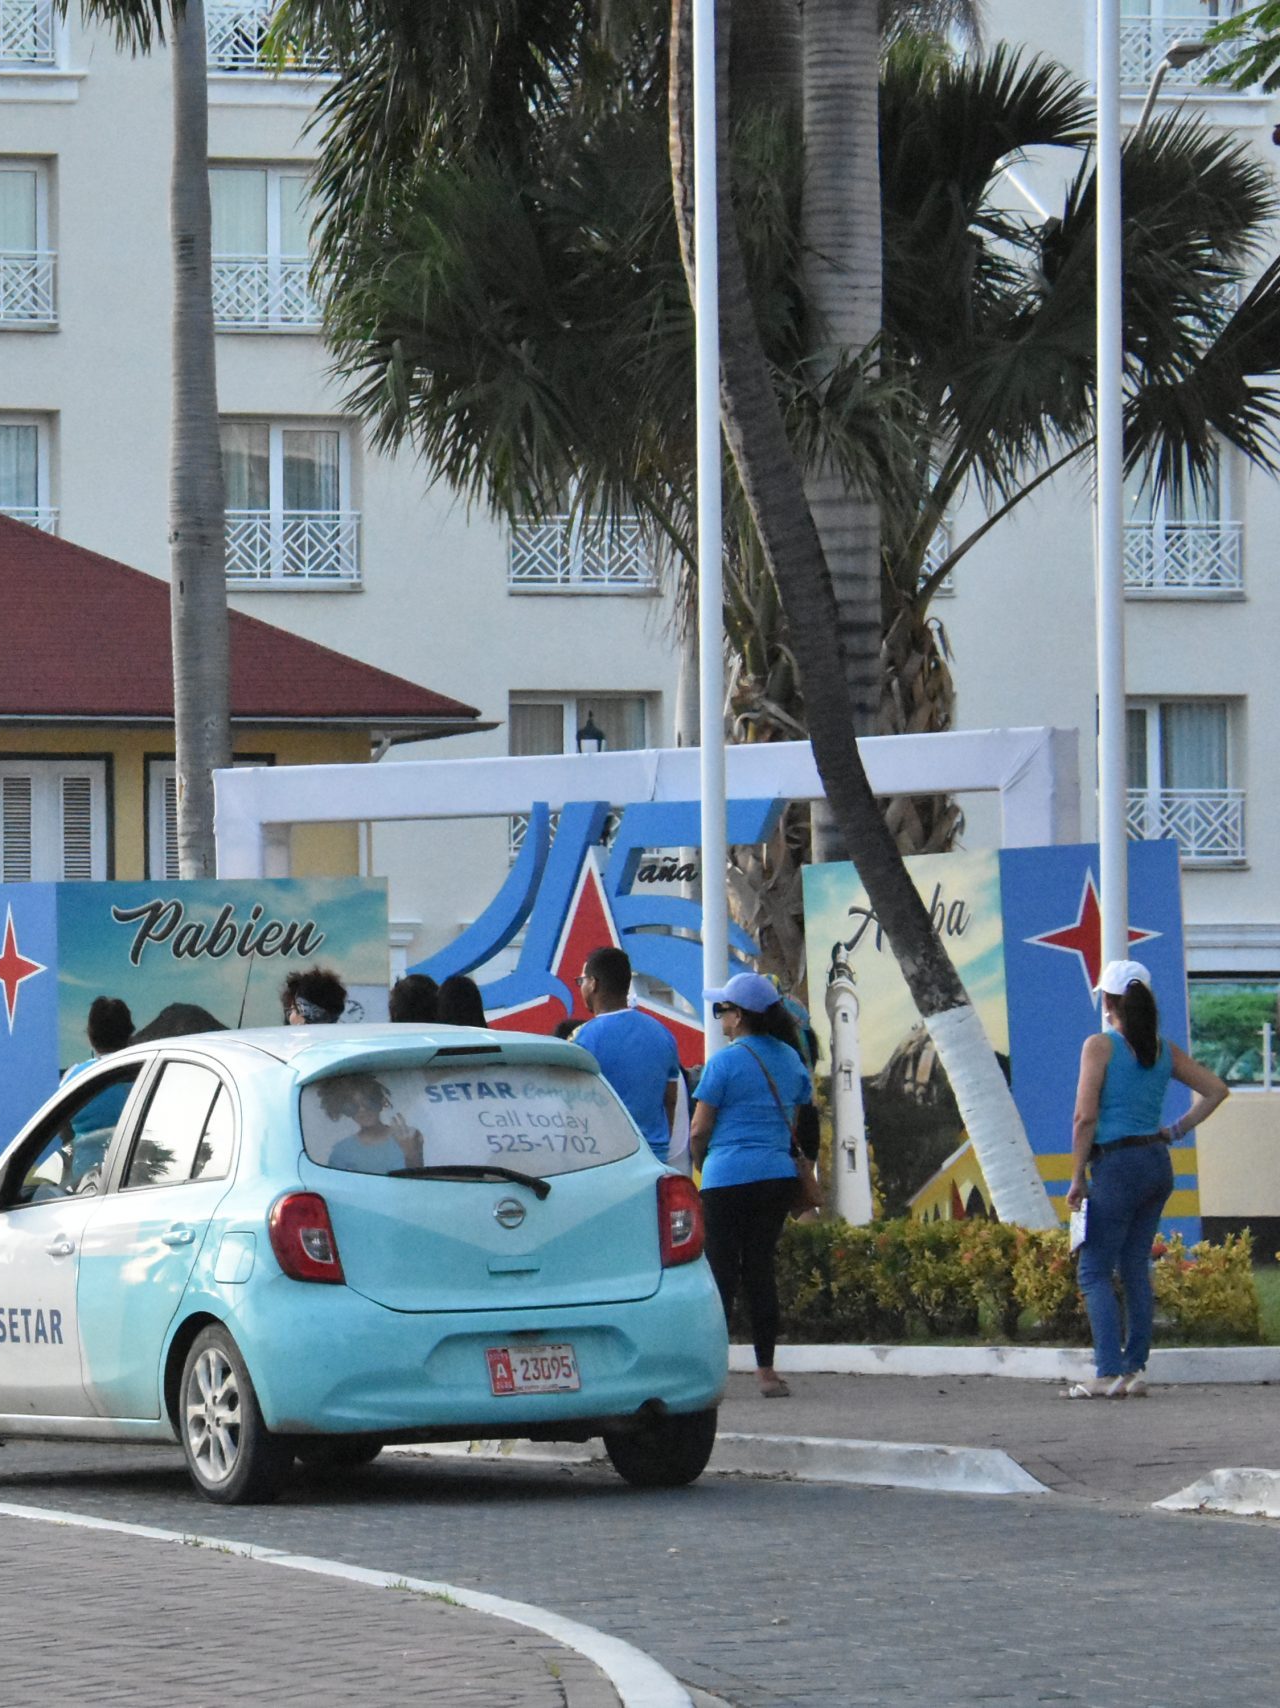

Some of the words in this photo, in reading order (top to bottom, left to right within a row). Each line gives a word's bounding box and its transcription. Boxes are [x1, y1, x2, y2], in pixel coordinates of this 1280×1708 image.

[638, 856, 698, 883] aña
[111, 898, 325, 967] Pabien
[425, 1081, 516, 1103] SETAR
[478, 1110, 521, 1128] Call
[526, 1112, 589, 1133] today
[486, 1134, 601, 1155] 525-1702
